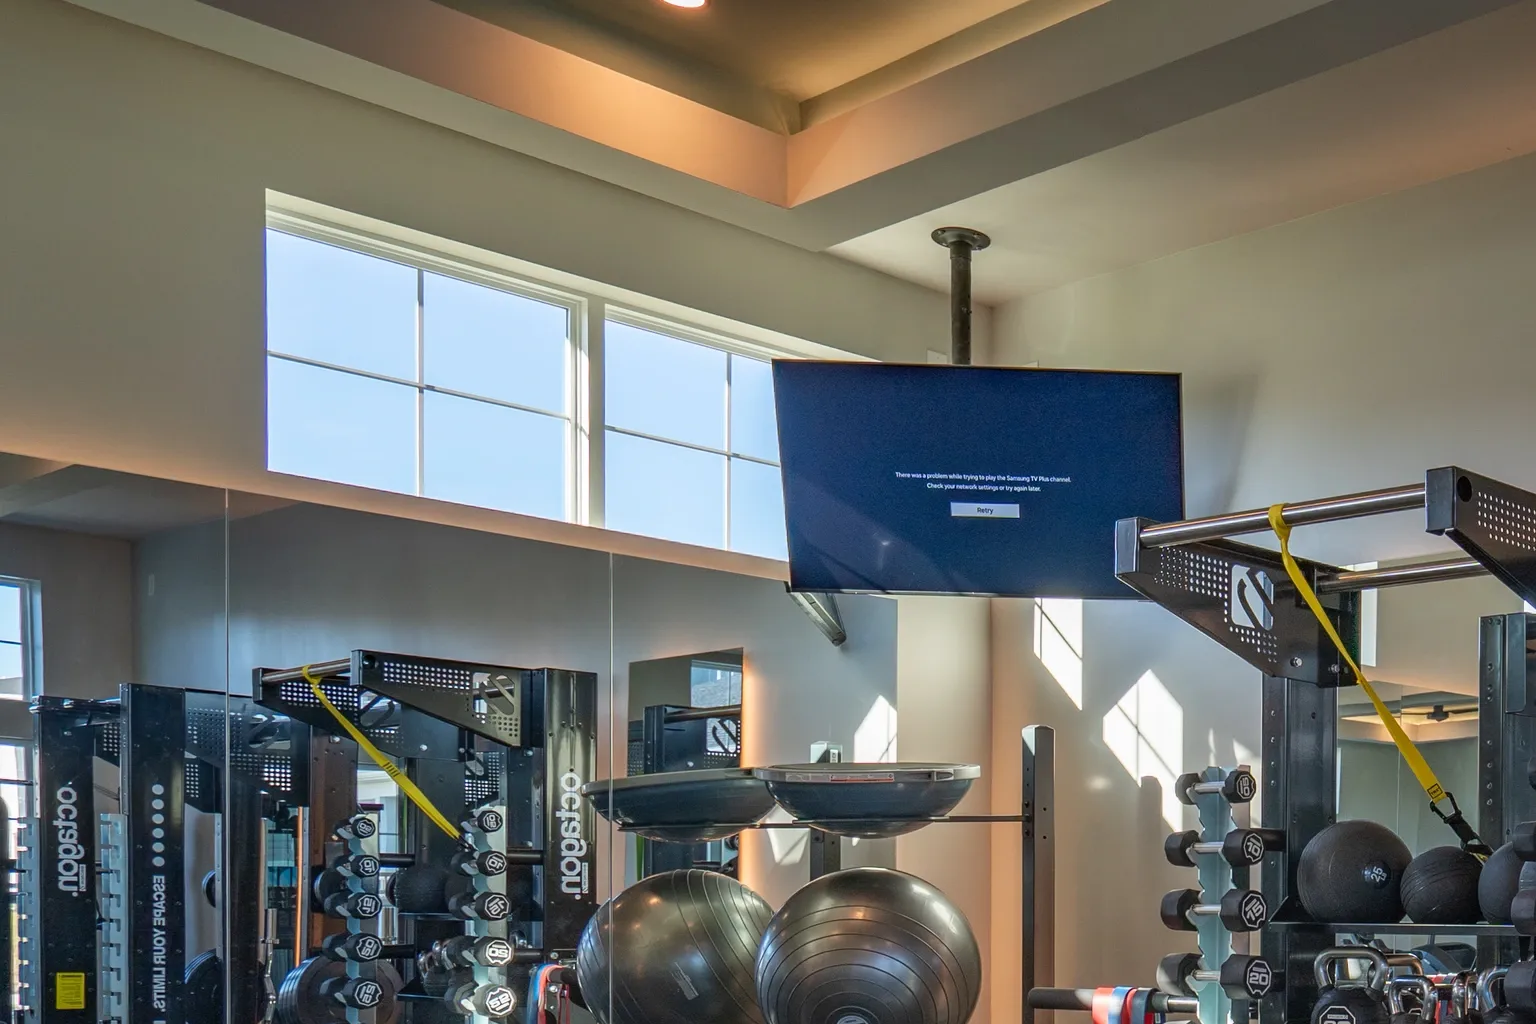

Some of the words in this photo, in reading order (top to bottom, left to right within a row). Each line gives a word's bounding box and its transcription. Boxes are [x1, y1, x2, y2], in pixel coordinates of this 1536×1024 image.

[963, 474, 979, 482] trying
[1007, 475, 1030, 483] Samsung
[976, 507, 994, 515] Retry
[1247, 840, 1260, 856] 10
[1370, 866, 1383, 882] 25
[1246, 900, 1262, 921] 15
[1249, 972, 1268, 985] 20
